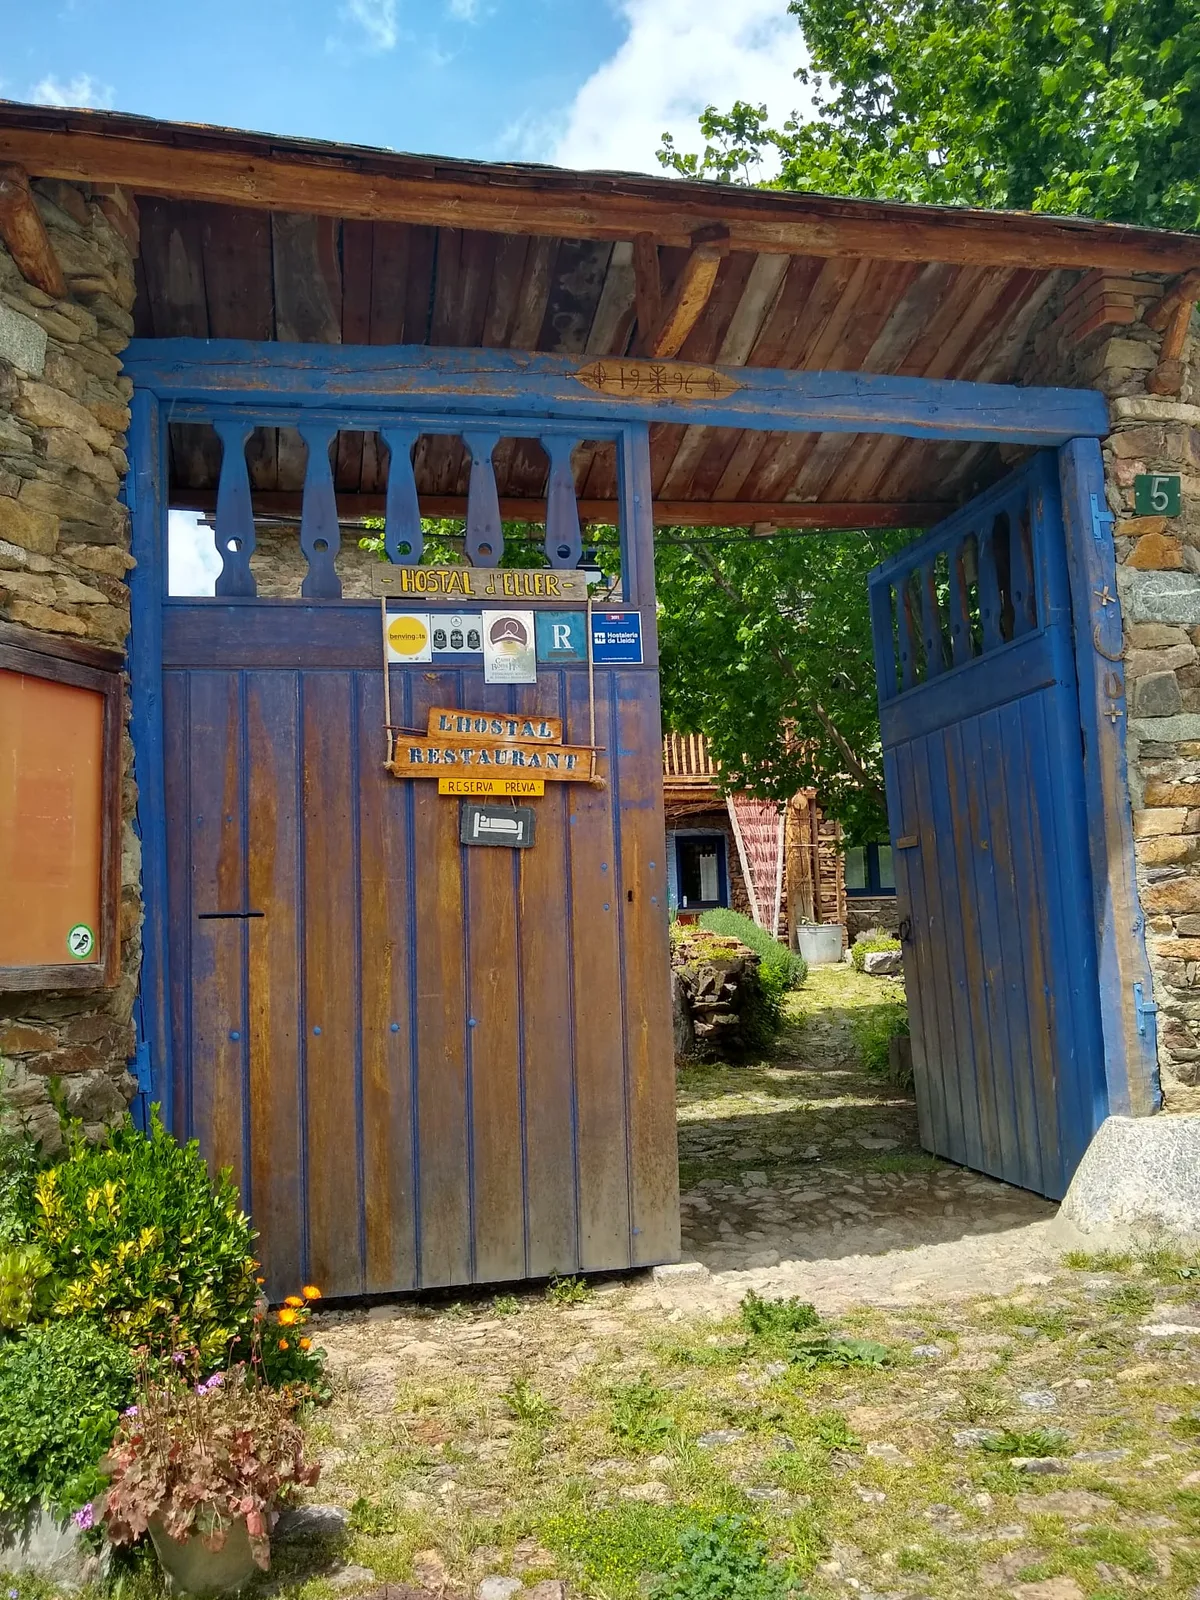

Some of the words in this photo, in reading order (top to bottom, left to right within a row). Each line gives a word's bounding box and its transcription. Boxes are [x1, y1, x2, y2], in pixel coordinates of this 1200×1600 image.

[1150, 477, 1169, 511] 5
[400, 568, 475, 595] HOSTAL
[551, 624, 574, 649] R
[438, 714, 553, 739] L'HOSTAL
[408, 746, 579, 770] RESTAURANT
[447, 781, 494, 793] RESERVA
